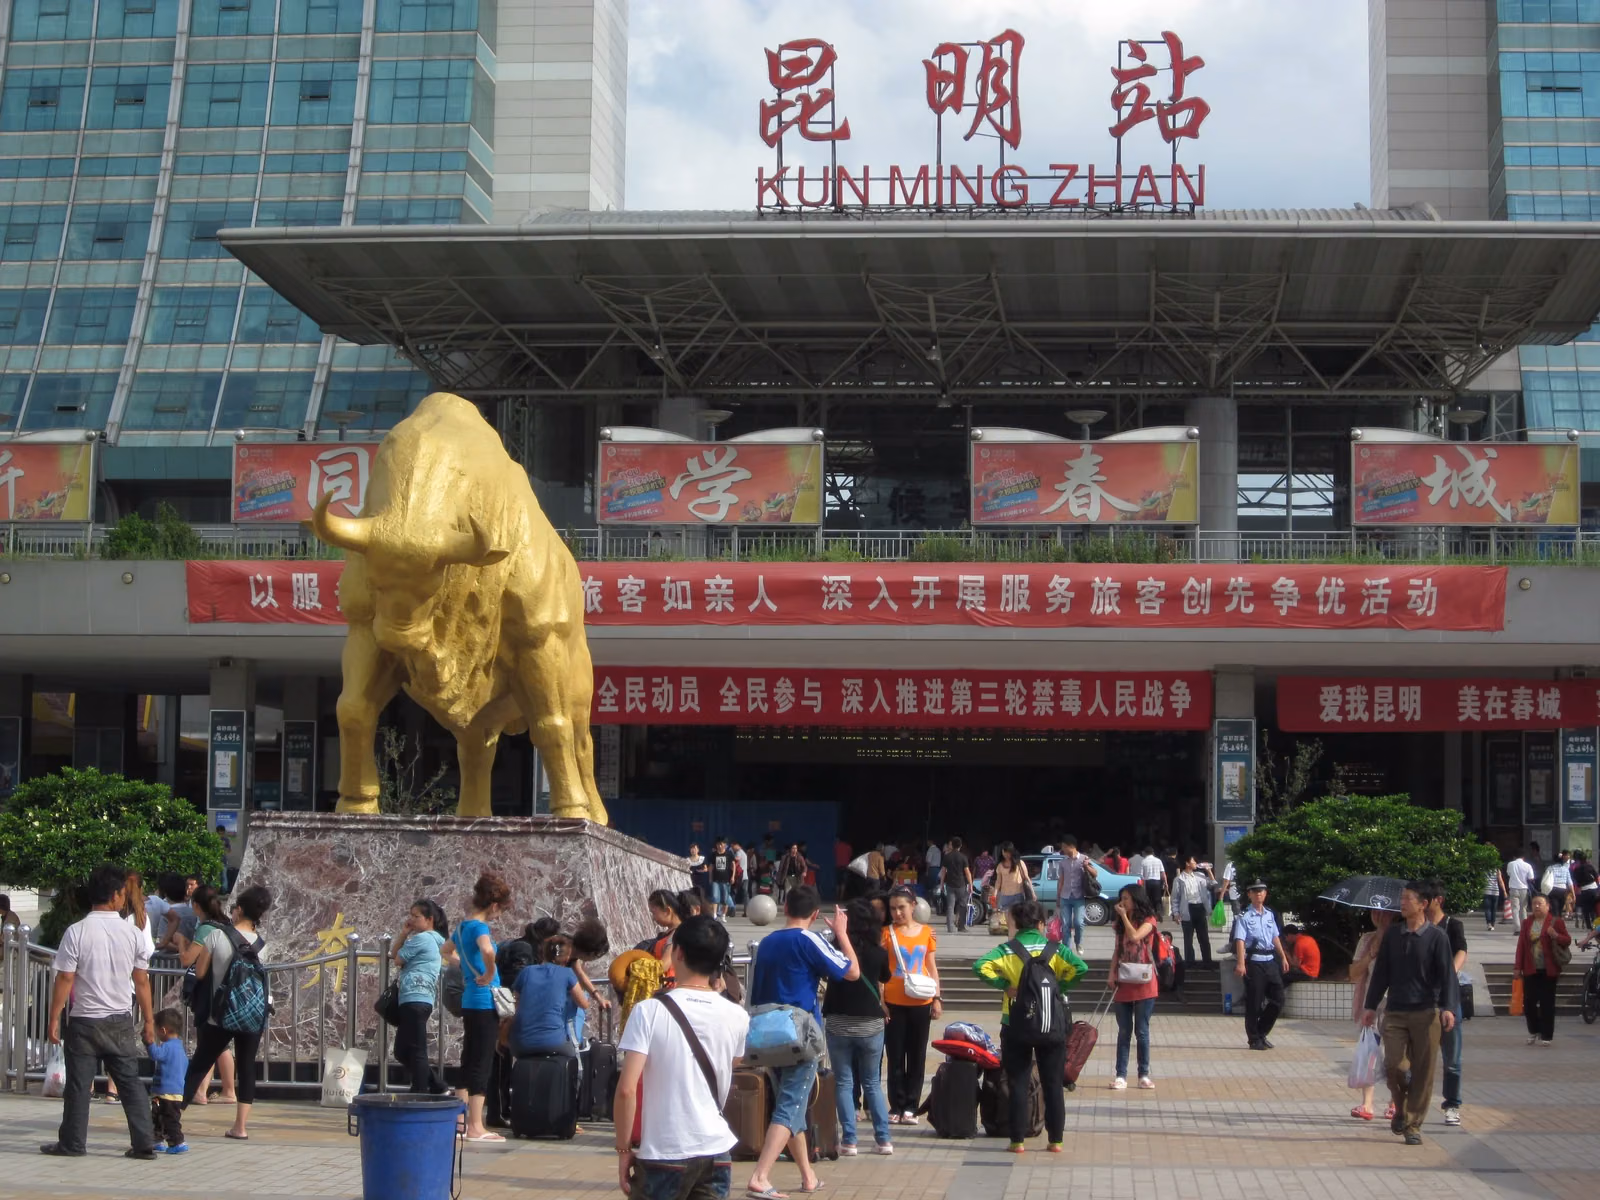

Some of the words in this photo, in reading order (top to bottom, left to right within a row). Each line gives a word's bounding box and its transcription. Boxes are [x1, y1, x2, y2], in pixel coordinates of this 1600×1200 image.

[759, 28, 1210, 150] 昆明站
[307, 447, 369, 517] 同
[669, 446, 752, 522] 学
[1040, 444, 1141, 522] 春
[1421, 445, 1512, 522] 城
[598, 676, 700, 713] 全民动员
[719, 676, 822, 714] 全民参与
[841, 677, 1191, 719] 深入推进第三轮禁毒人民战争
[1319, 684, 1422, 723] 爱我昆明
[1458, 685, 1561, 722] 美在春城
